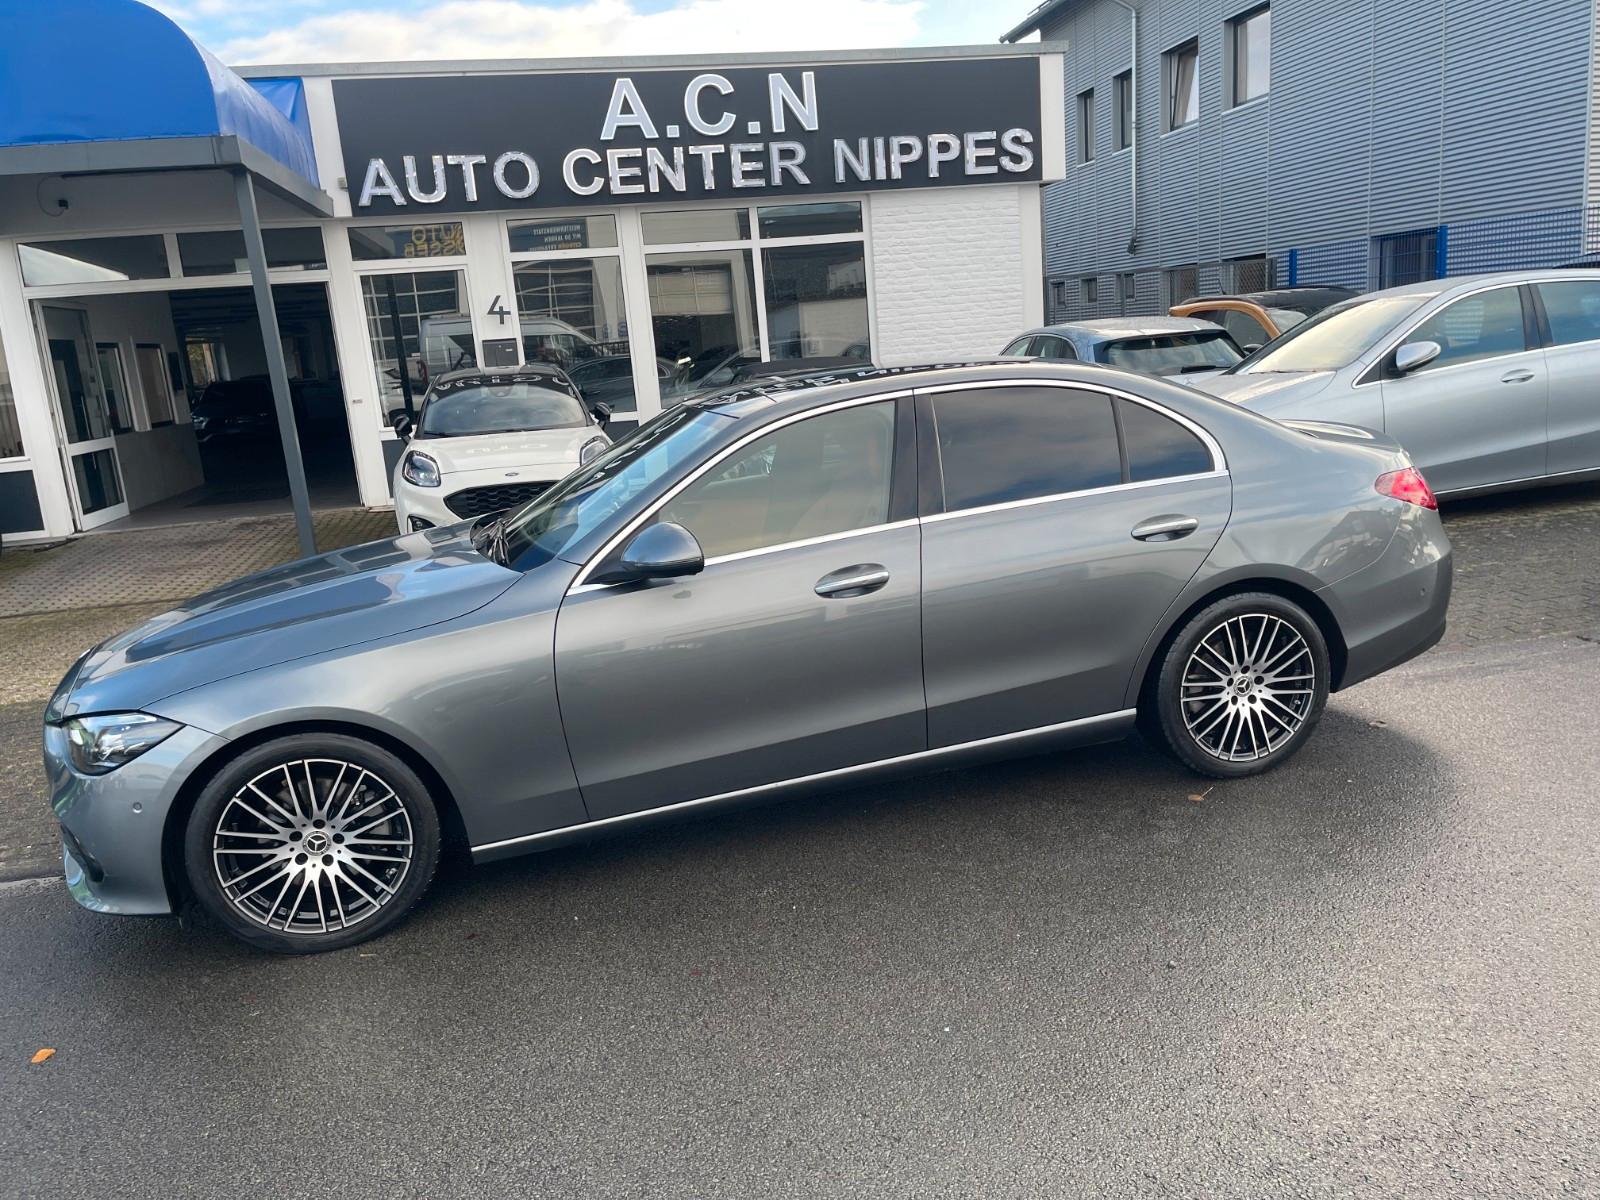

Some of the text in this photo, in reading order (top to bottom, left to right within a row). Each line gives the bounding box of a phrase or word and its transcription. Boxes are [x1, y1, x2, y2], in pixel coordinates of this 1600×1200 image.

[600, 71, 819, 141] A.C.N
[358, 128, 1035, 207] AUTO CENTER NIPPES
[487, 295, 511, 325] 4
